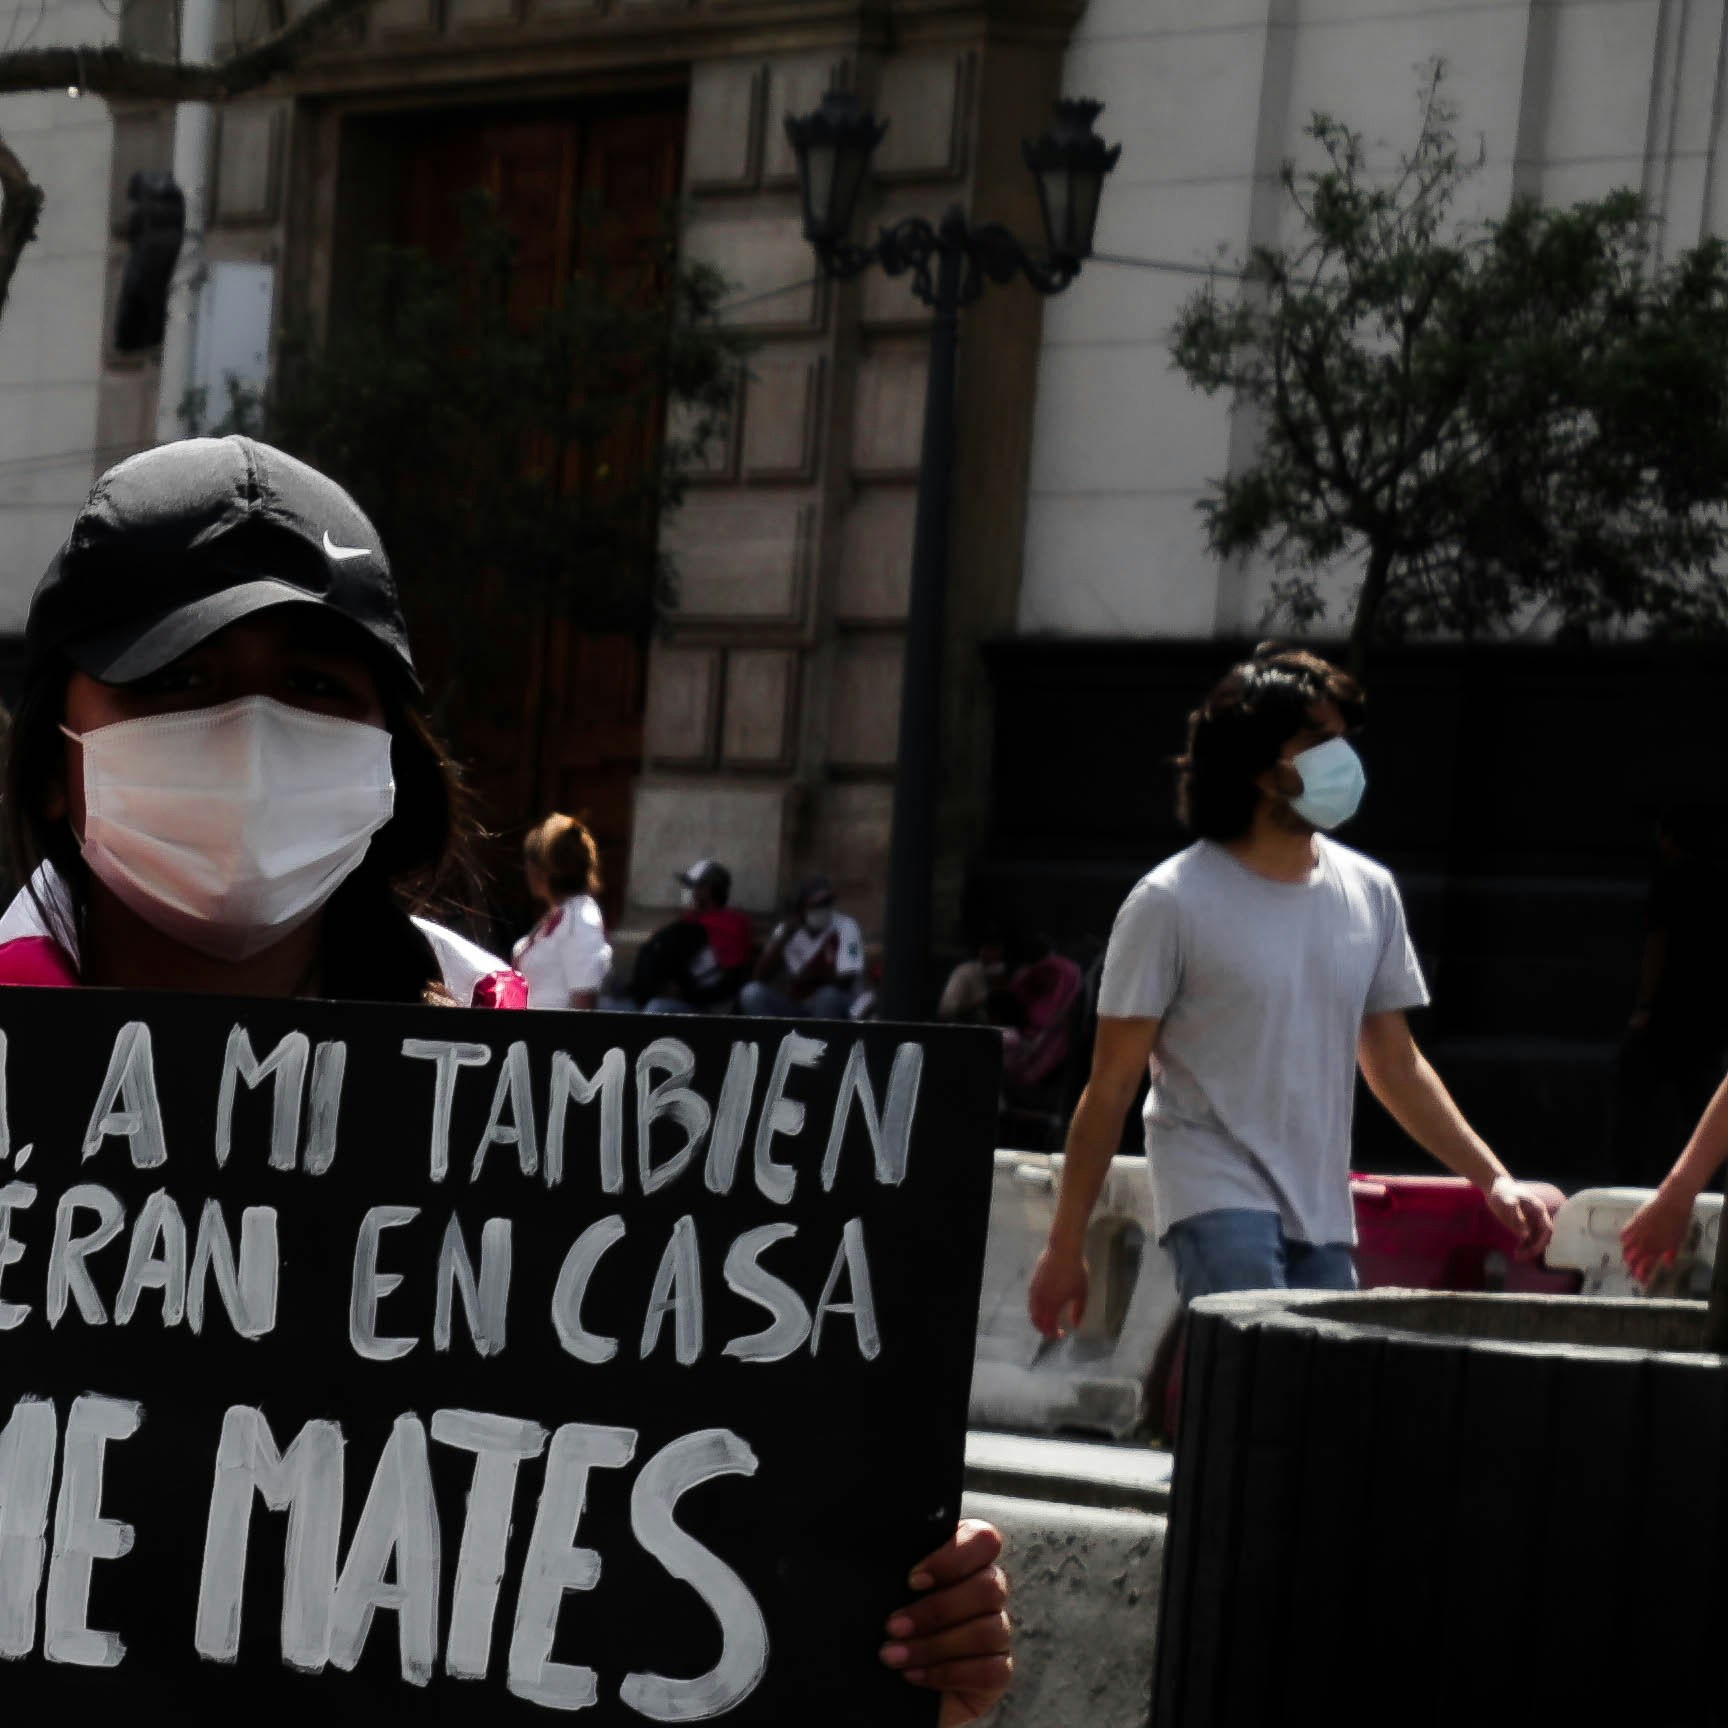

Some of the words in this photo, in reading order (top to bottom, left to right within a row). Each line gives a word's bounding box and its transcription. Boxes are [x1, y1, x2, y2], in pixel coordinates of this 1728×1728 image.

[82, 1022, 166, 1167] A
[217, 1024, 345, 1174] MI
[402, 1030, 922, 1203] TAMBIEN
[350, 1207, 511, 1359] EN
[553, 1215, 879, 1365] CASA
[196, 1406, 768, 1721] MATES
